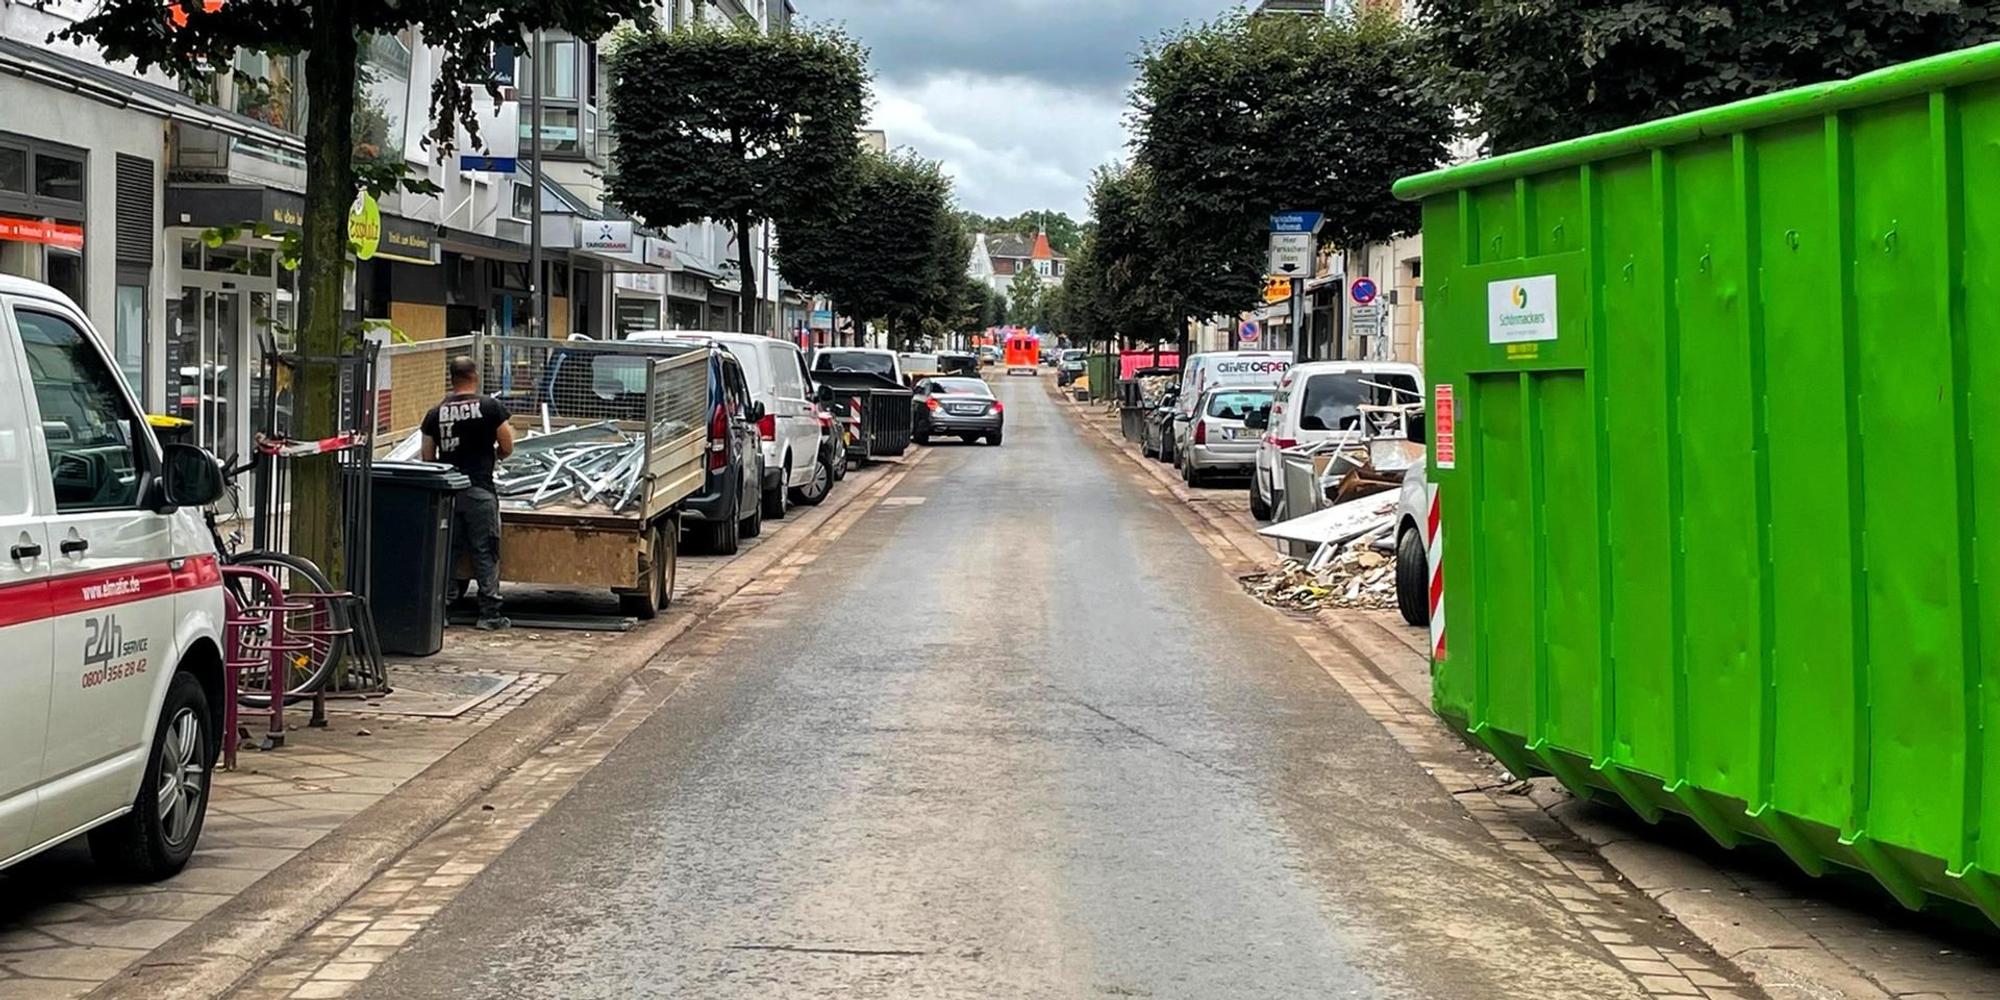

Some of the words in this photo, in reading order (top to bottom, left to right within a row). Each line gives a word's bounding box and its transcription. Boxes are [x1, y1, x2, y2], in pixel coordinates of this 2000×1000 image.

[1499, 311, 1546, 326] Schönmackers
[439, 402, 483, 422] BACK
[439, 422, 455, 438] IT
[82, 576, 140, 600] www.elmatic.de
[84, 614, 121, 679] 24h
[123, 638, 148, 656] SERVICE
[82, 669, 103, 688] 0800
[107, 665, 123, 681] 356
[124, 661, 135, 677] 28
[136, 658, 147, 672] 42
